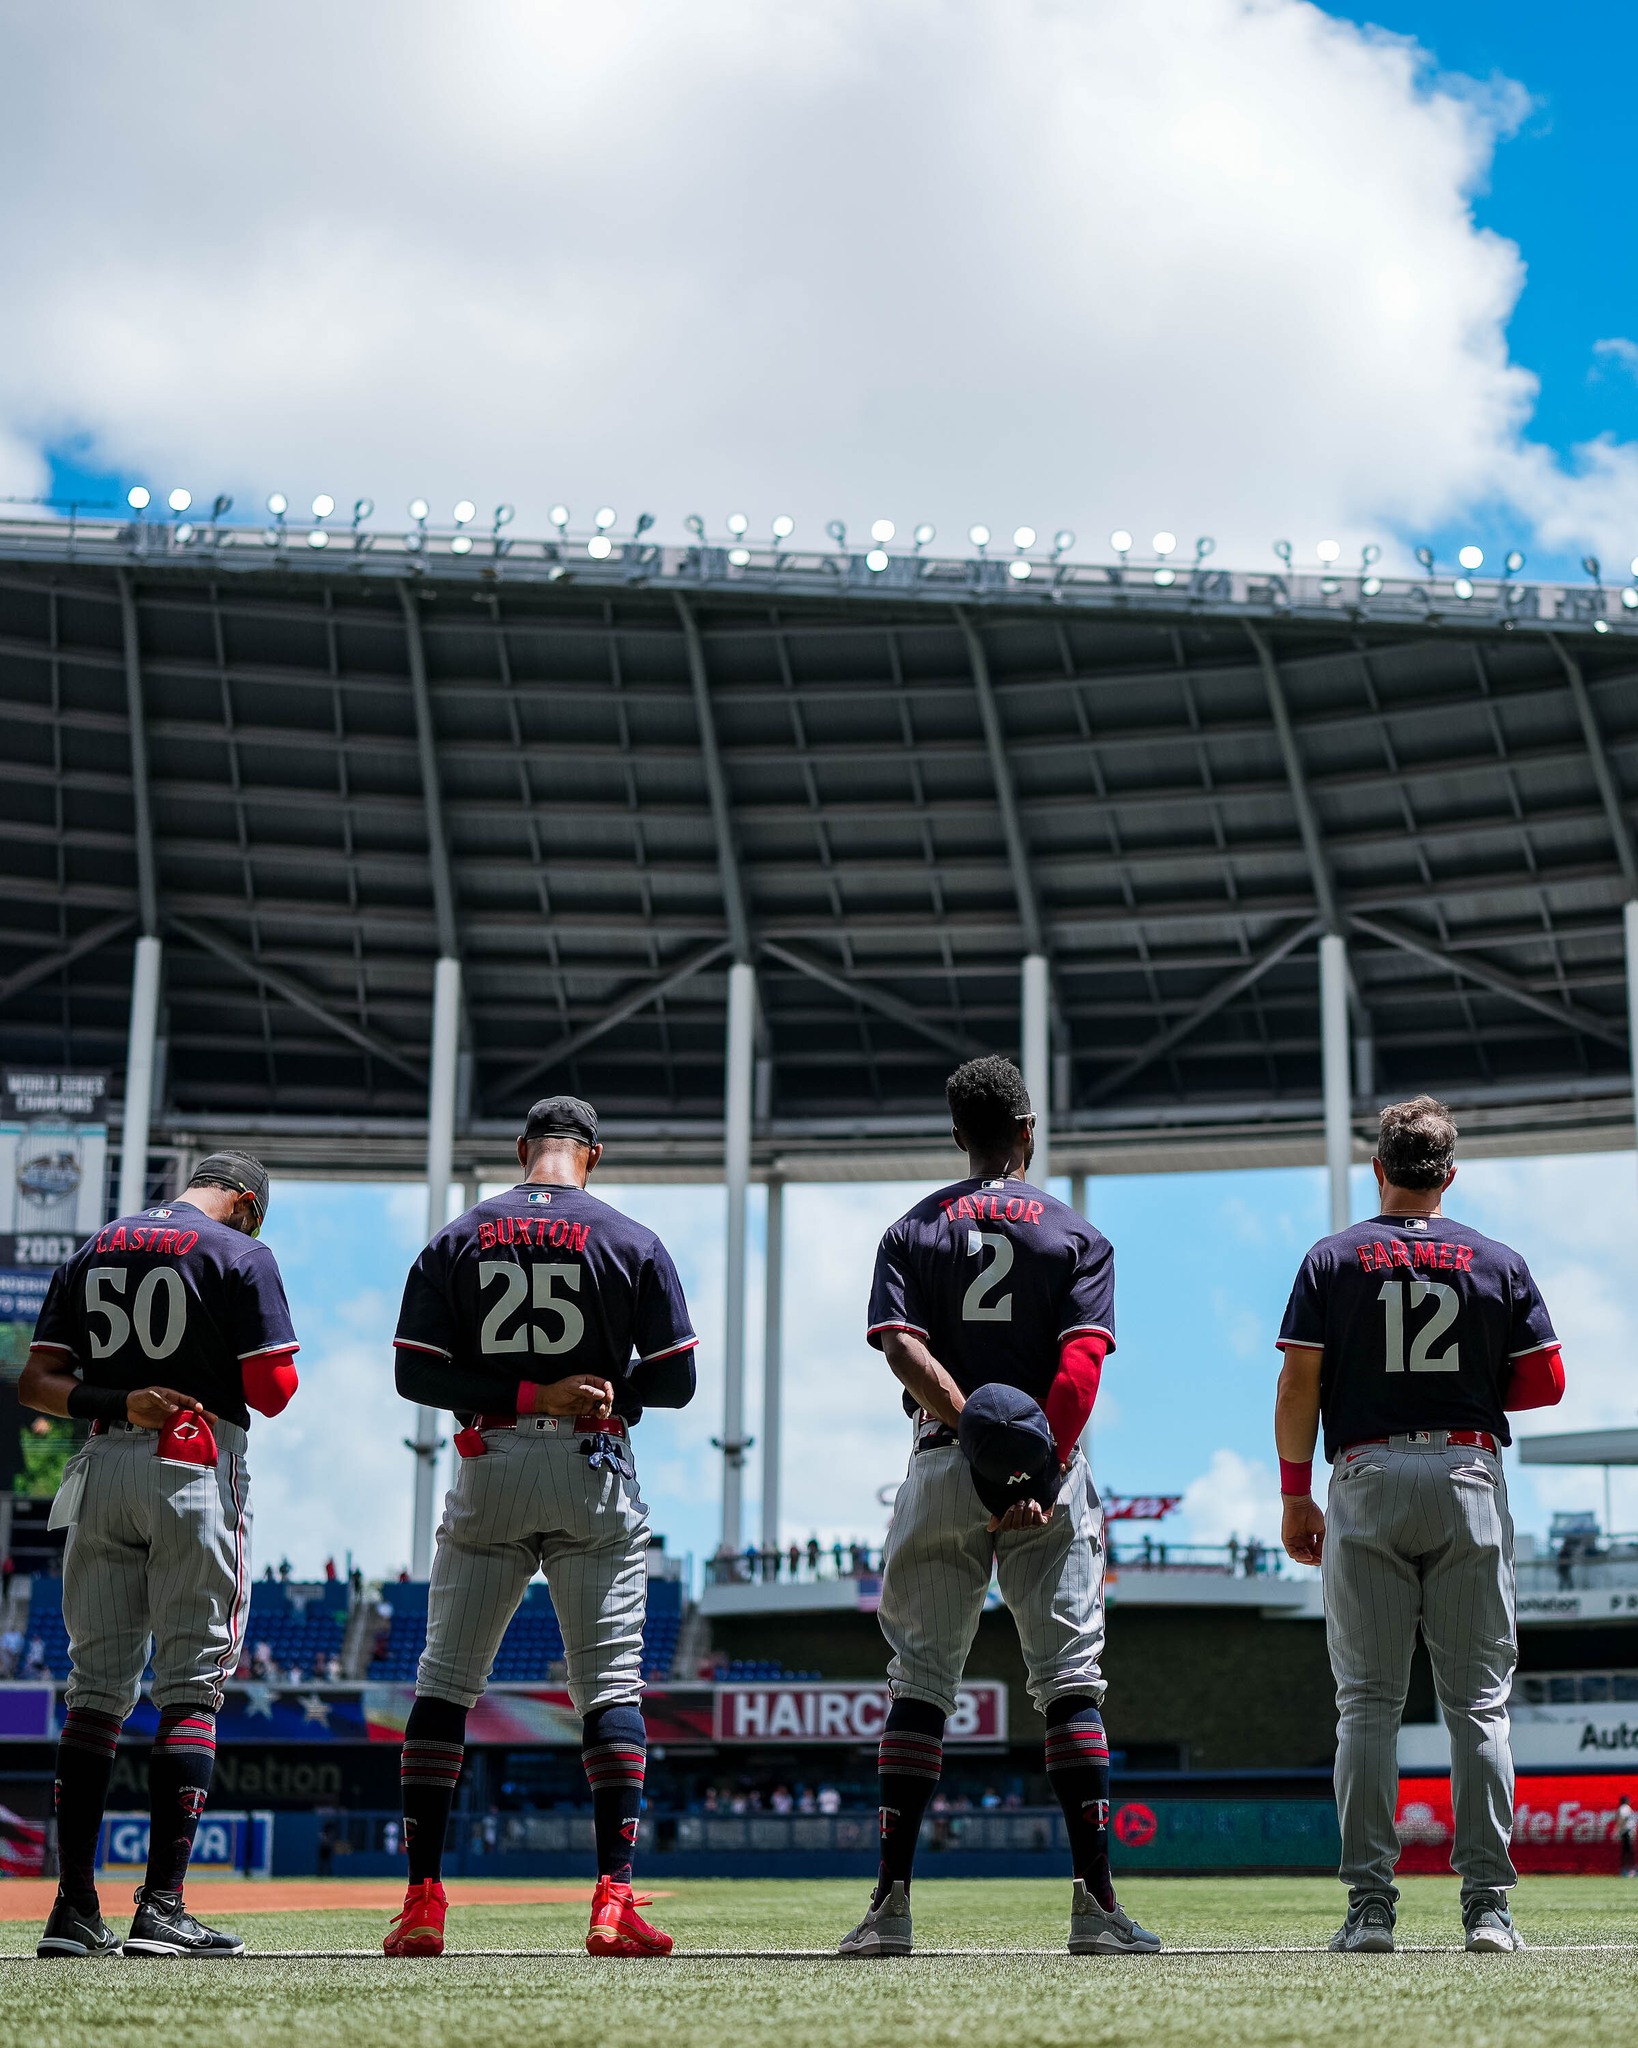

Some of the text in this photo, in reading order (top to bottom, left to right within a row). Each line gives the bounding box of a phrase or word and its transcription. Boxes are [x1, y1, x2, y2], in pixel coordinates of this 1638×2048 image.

[939, 1194, 1045, 1225] TAYLOR
[95, 1226, 199, 1256] CASTRO
[477, 1216, 591, 1252] BUXTON
[962, 1229, 1014, 1322] 2
[1356, 1239, 1474, 1273] FARMER
[85, 1266, 187, 1360] 50
[478, 1260, 585, 1355] 25
[1376, 1280, 1460, 1373] 12
[734, 1692, 980, 1736] HAIRCB
[104, 1754, 342, 1793] ANation
[112, 1824, 230, 1862] GA
